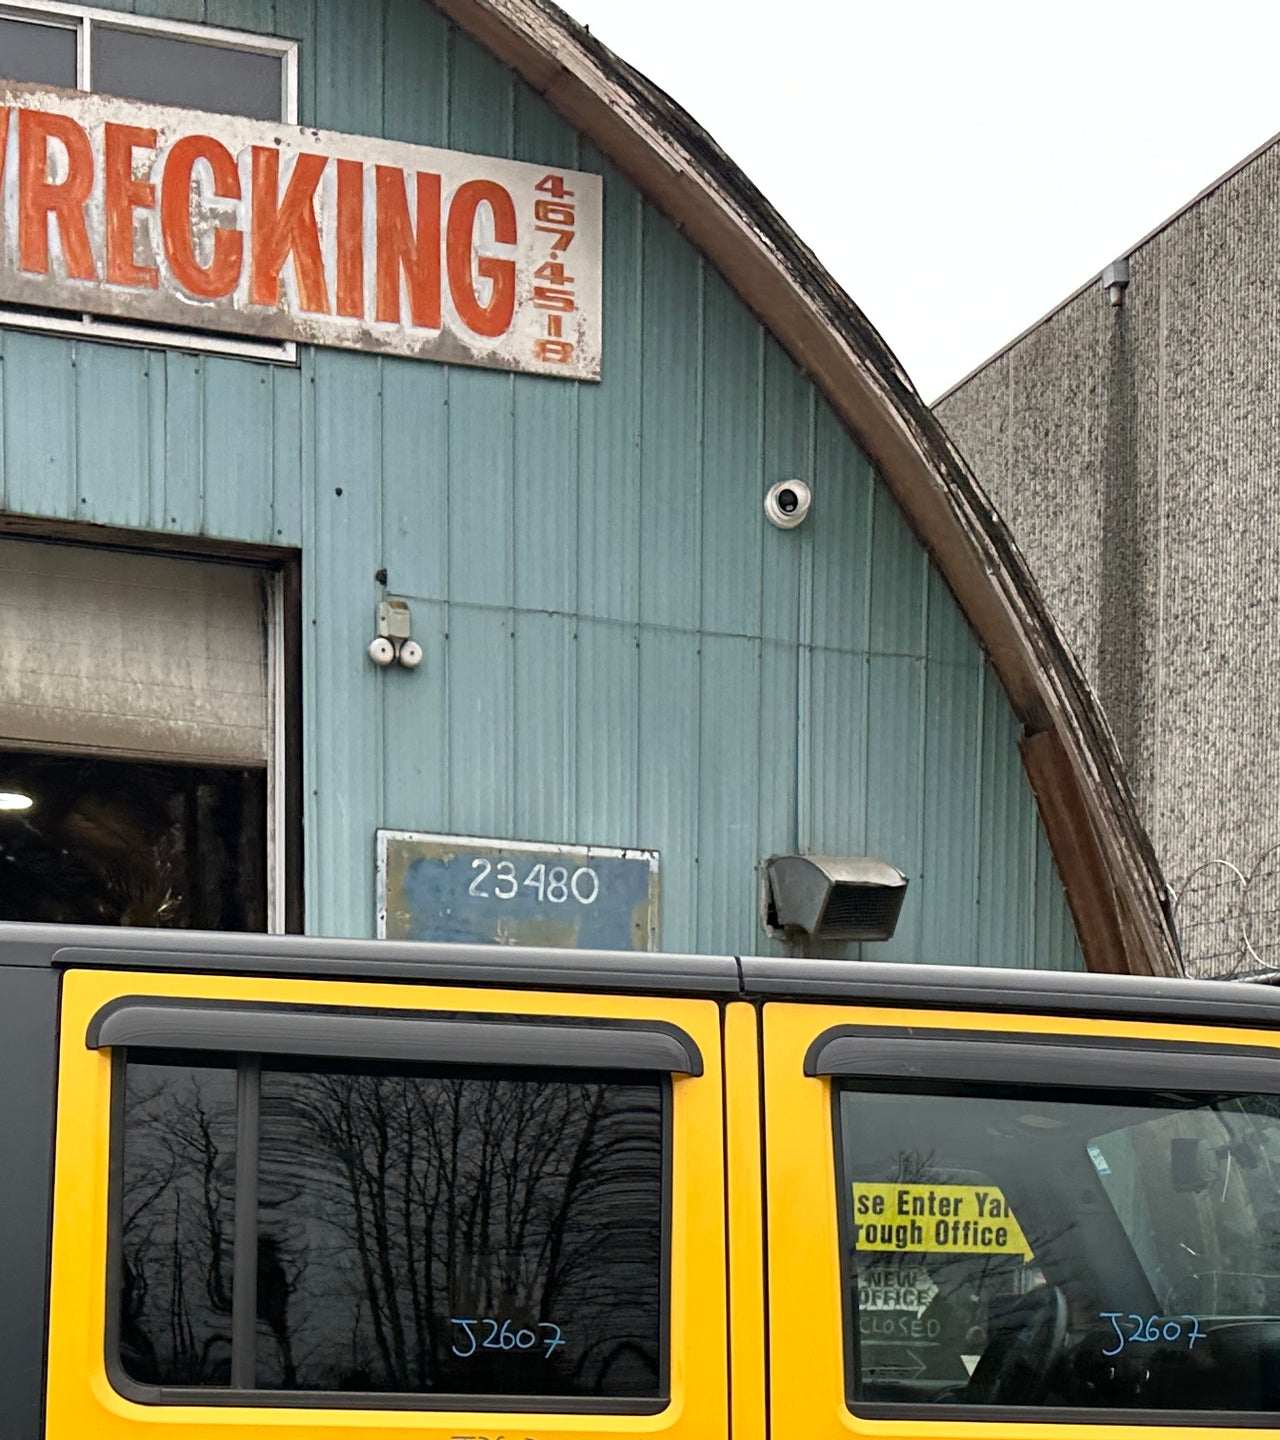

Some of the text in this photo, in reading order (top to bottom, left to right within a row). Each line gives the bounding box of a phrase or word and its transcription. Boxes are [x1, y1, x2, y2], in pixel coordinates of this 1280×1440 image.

[468, 858, 600, 905] 23480
[897, 1190, 963, 1217] Enter
[934, 1219, 1008, 1247] Office
[866, 1269, 919, 1287] NEW
[450, 1319, 567, 1359] J2607
[1099, 1313, 1208, 1356] J2607
